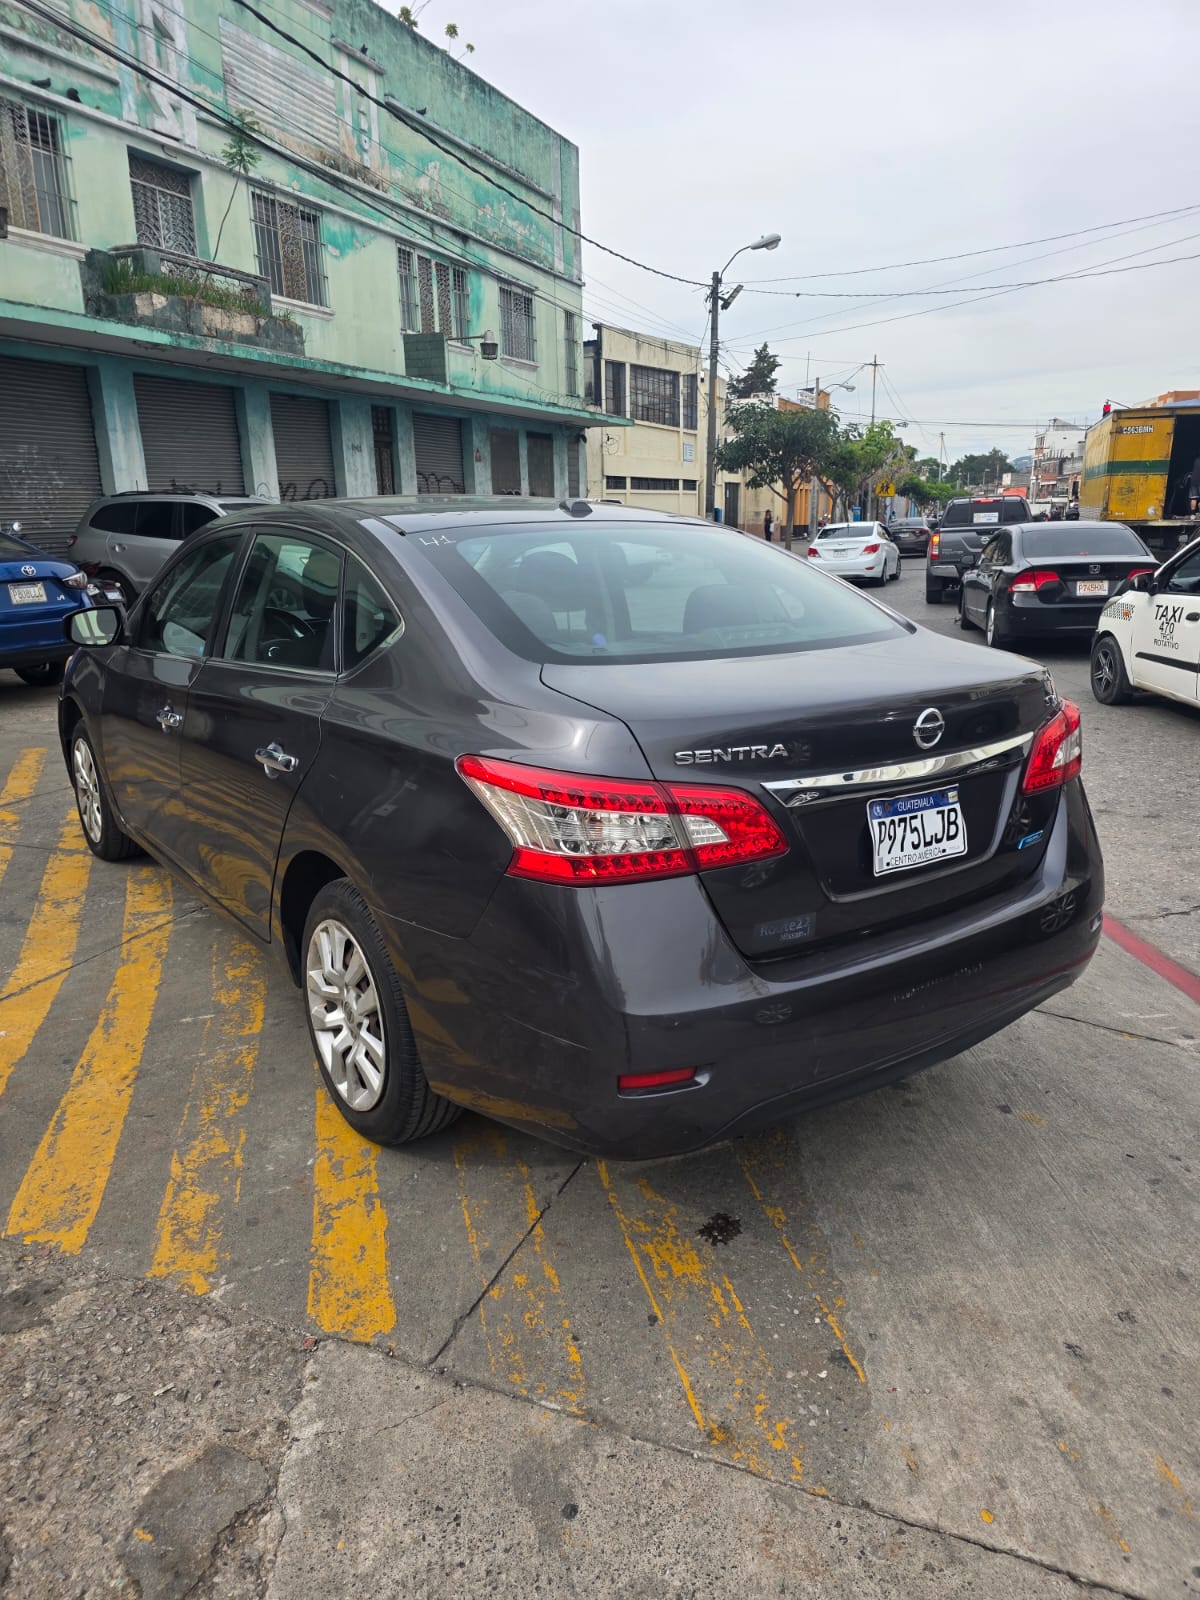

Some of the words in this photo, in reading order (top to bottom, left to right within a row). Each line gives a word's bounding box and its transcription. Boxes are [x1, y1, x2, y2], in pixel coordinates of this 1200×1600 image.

[1154, 604, 1184, 623] TAXI
[1159, 621, 1175, 634] 470
[1153, 638, 1179, 650] ROTATIVO
[674, 743, 789, 765] SENTRA
[897, 796, 935, 812] GUATEMALA
[877, 807, 960, 857] P975LJB
